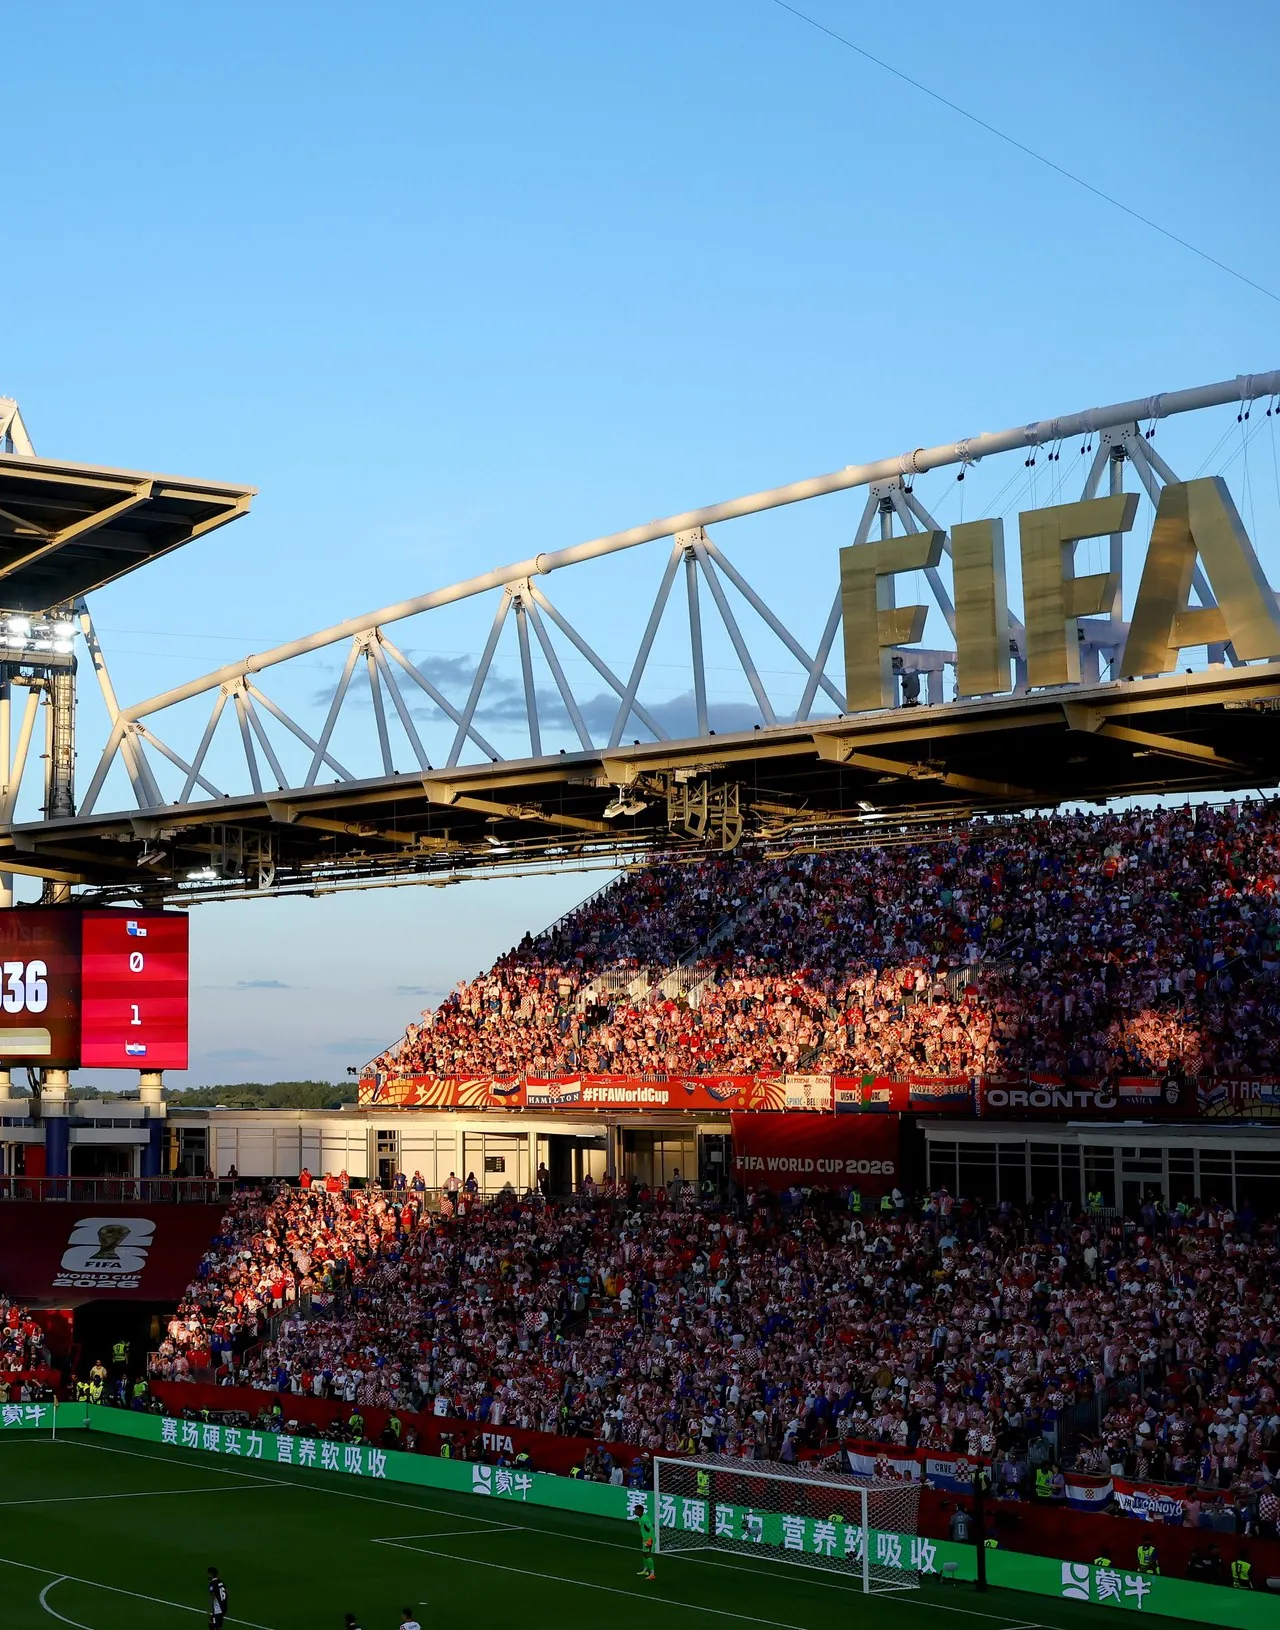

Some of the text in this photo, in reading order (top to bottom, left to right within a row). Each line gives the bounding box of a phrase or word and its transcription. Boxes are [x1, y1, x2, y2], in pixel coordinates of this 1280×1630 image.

[839, 476, 1280, 713] FIFA
[129, 951, 144, 973] 0
[130, 1004, 142, 1025] 1
[528, 1093, 580, 1105] HAMILTON
[582, 1087, 669, 1105] #FIFAWorldCup
[986, 1089, 1118, 1109] ORONTO
[736, 1156, 895, 1175] FIFA WORLD CUP 2026
[84, 1261, 122, 1269] FIFA
[52, 1279, 140, 1289] 2026
[56, 1272, 110, 1281] WORLD
[1, 1404, 47, 1427] 蒙牛
[161, 1417, 388, 1479] 赛场硬实力 营养软吸收
[482, 1432, 514, 1454] FIFA
[495, 1469, 533, 1501] 蒙牛
[781, 1515, 938, 1575] 营养软吸收
[1095, 1567, 1152, 1610] 蒙牛
